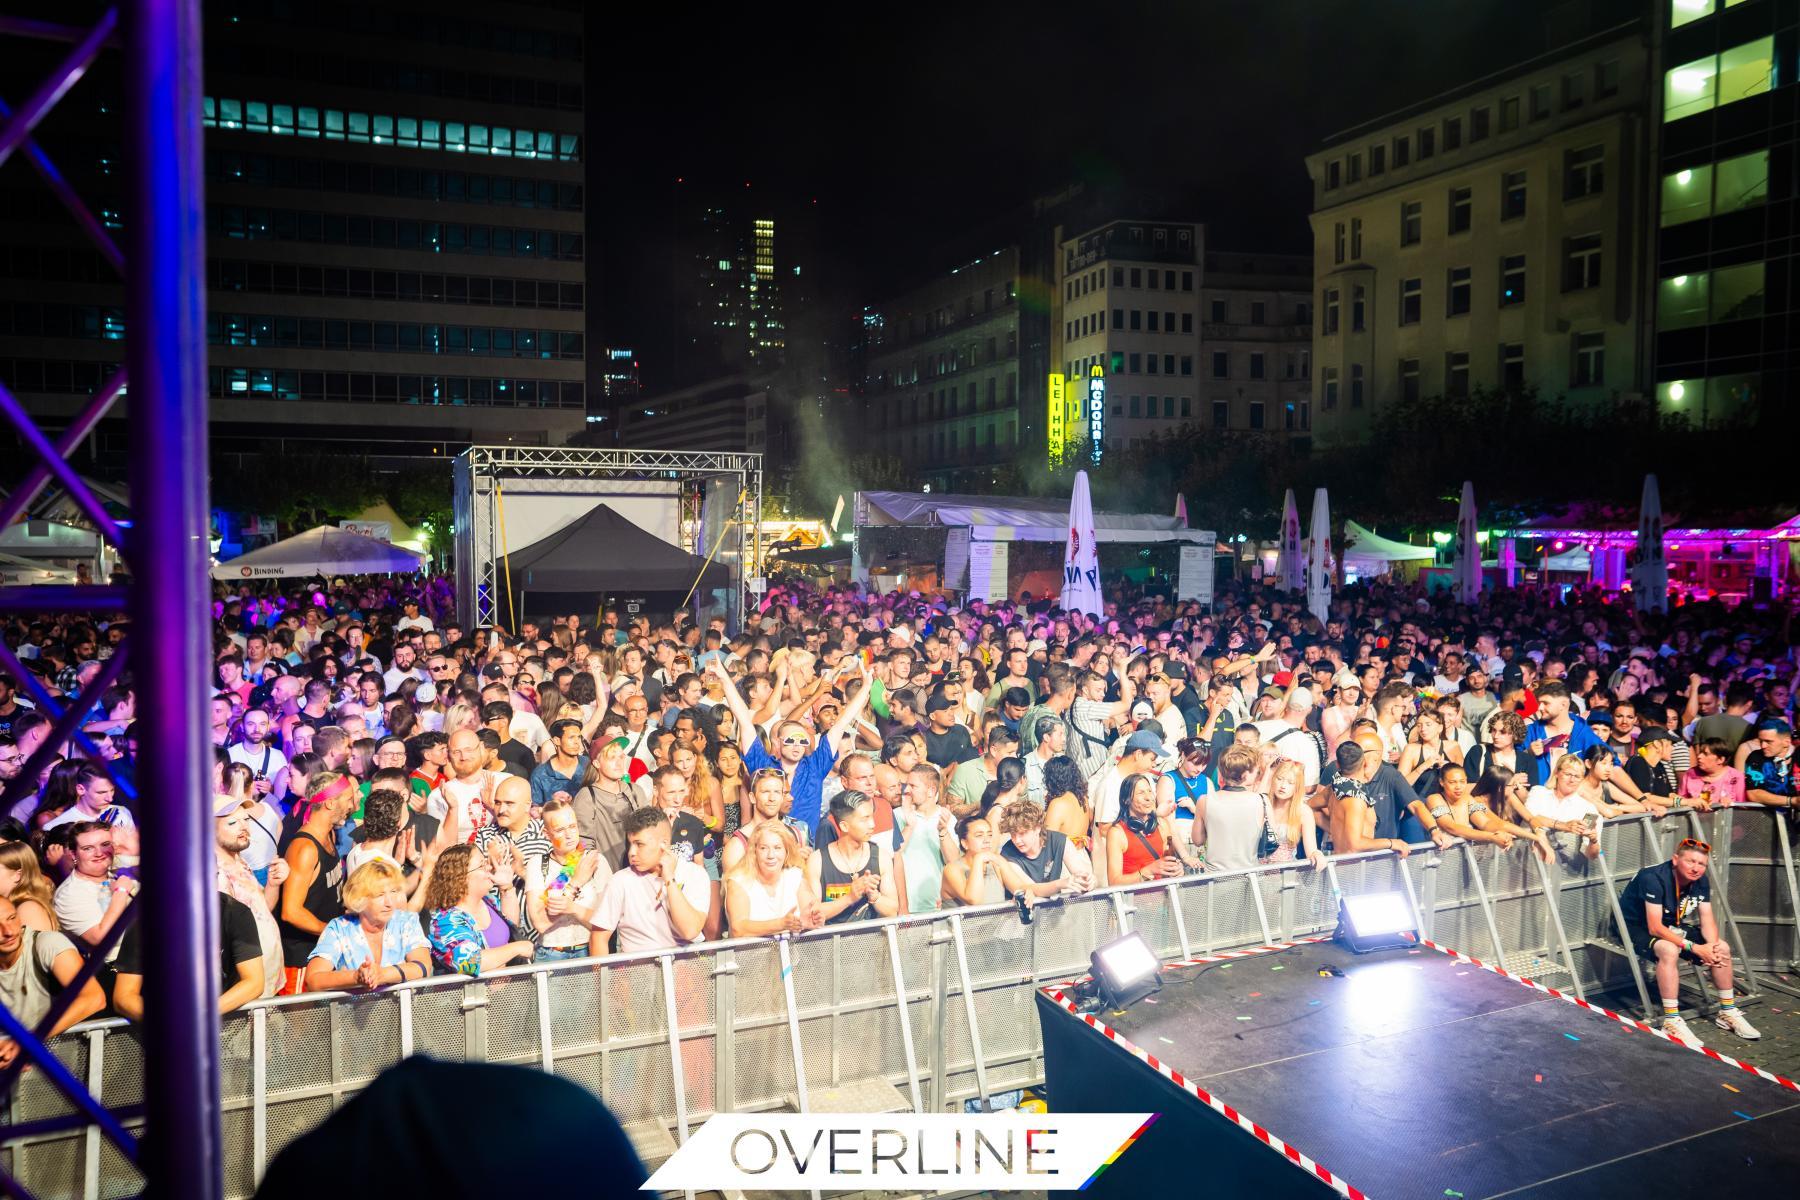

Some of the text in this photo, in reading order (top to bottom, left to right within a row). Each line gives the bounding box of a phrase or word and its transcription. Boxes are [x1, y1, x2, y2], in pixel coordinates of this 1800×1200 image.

[1052, 376, 1061, 461] LEIHHA
[1090, 379, 1104, 460] McDona
[254, 567, 284, 575] BINDING
